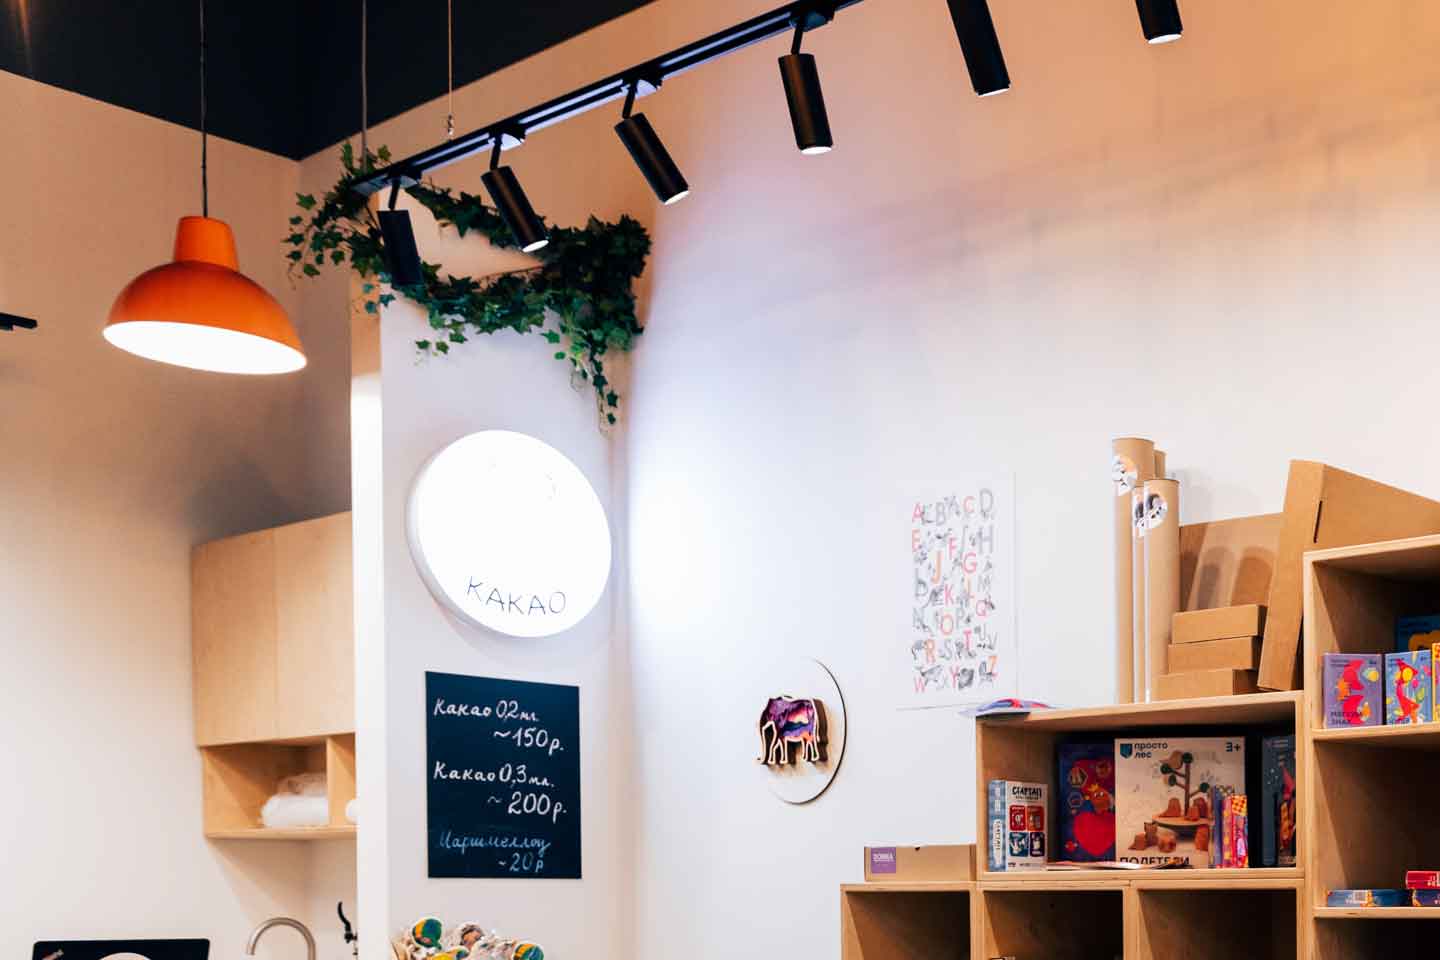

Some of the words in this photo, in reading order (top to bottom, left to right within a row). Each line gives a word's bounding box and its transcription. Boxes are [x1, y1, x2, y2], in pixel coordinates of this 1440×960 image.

[466, 575, 567, 617] КАКАО
[433, 698, 492, 718] Какао
[1134, 751, 1153, 759] лес
[1225, 741, 1241, 753] 3+
[433, 761, 496, 782] Какао
